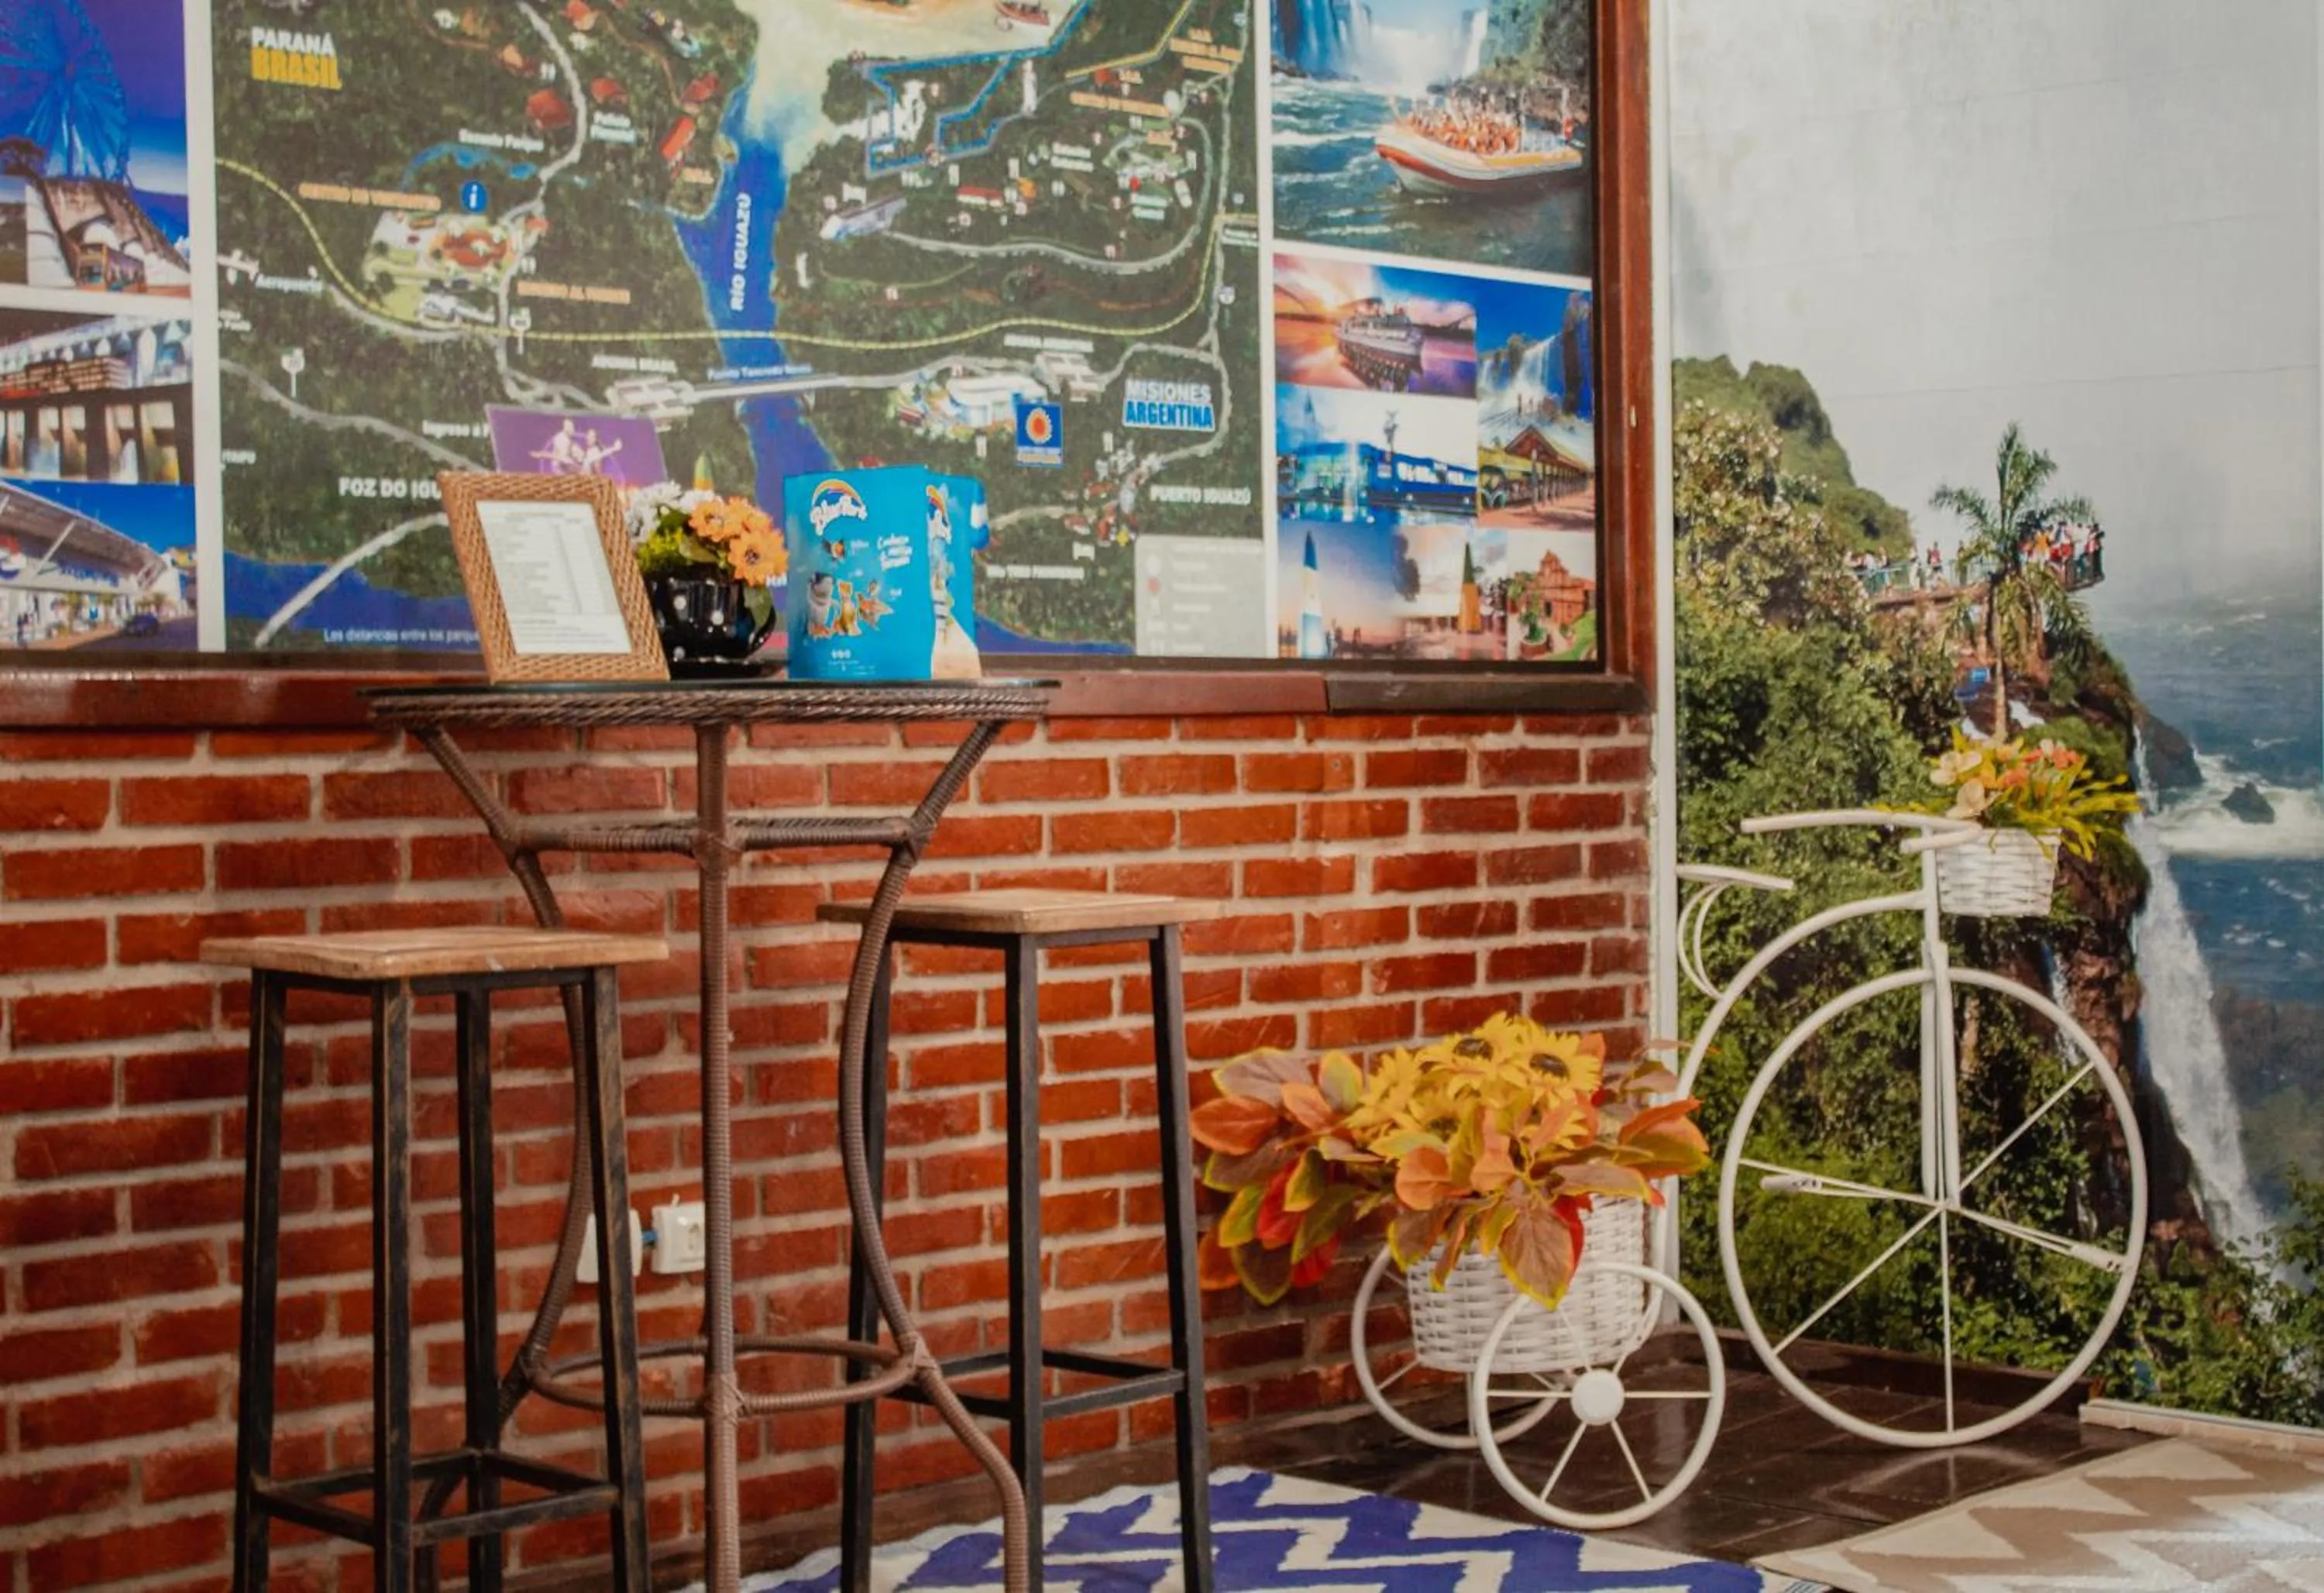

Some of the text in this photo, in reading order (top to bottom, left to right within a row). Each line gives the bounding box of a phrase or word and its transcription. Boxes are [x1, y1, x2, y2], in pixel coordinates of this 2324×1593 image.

[252, 47, 342, 91] BRASIL
[1125, 377, 1212, 403] MISIONES
[1124, 399, 1215, 429] ARGENTINA
[339, 477, 442, 501] FOZ DO IGU
[1150, 484, 1252, 506] PUERTO IGUAZÚ
